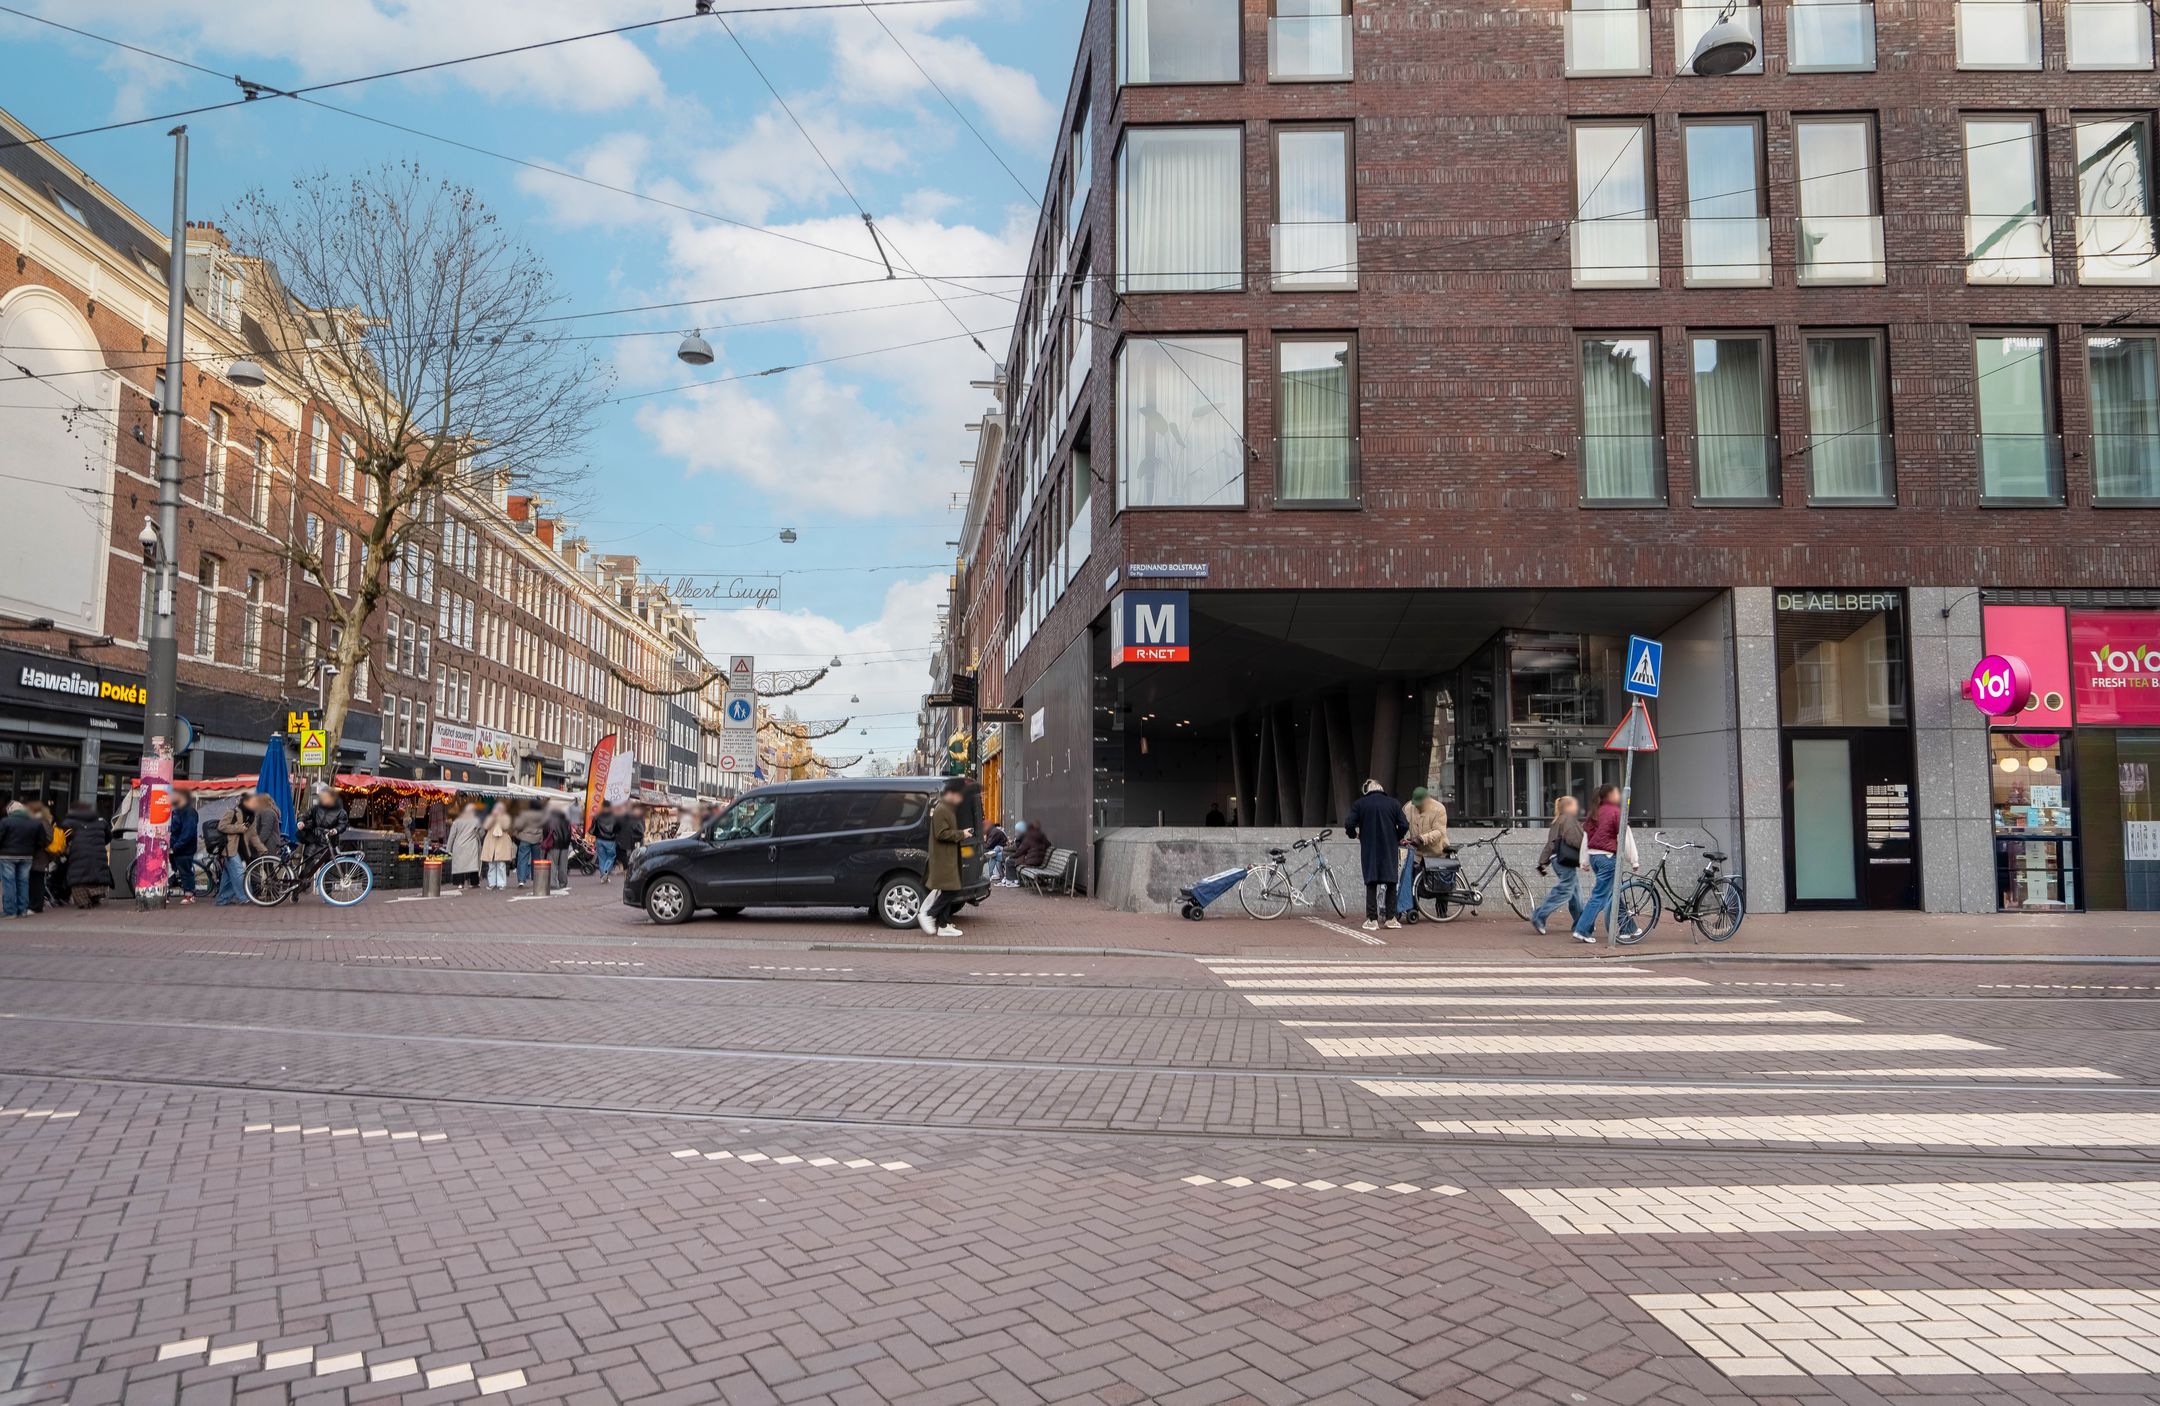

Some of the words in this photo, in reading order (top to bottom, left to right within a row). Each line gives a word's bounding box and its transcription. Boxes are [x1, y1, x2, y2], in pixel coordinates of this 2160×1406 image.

[654, 576, 719, 599] Albert
[729, 578, 778, 608] Cuyp
[1778, 594, 1804, 610] DE
[1808, 594, 1896, 610] AELBERT
[1136, 604, 1174, 643] M
[20, 667, 100, 698] Hawaiian
[1974, 669, 2010, 700] YO!
[2092, 678, 2126, 688] FRESH
[2128, 678, 2149, 688] TEA
